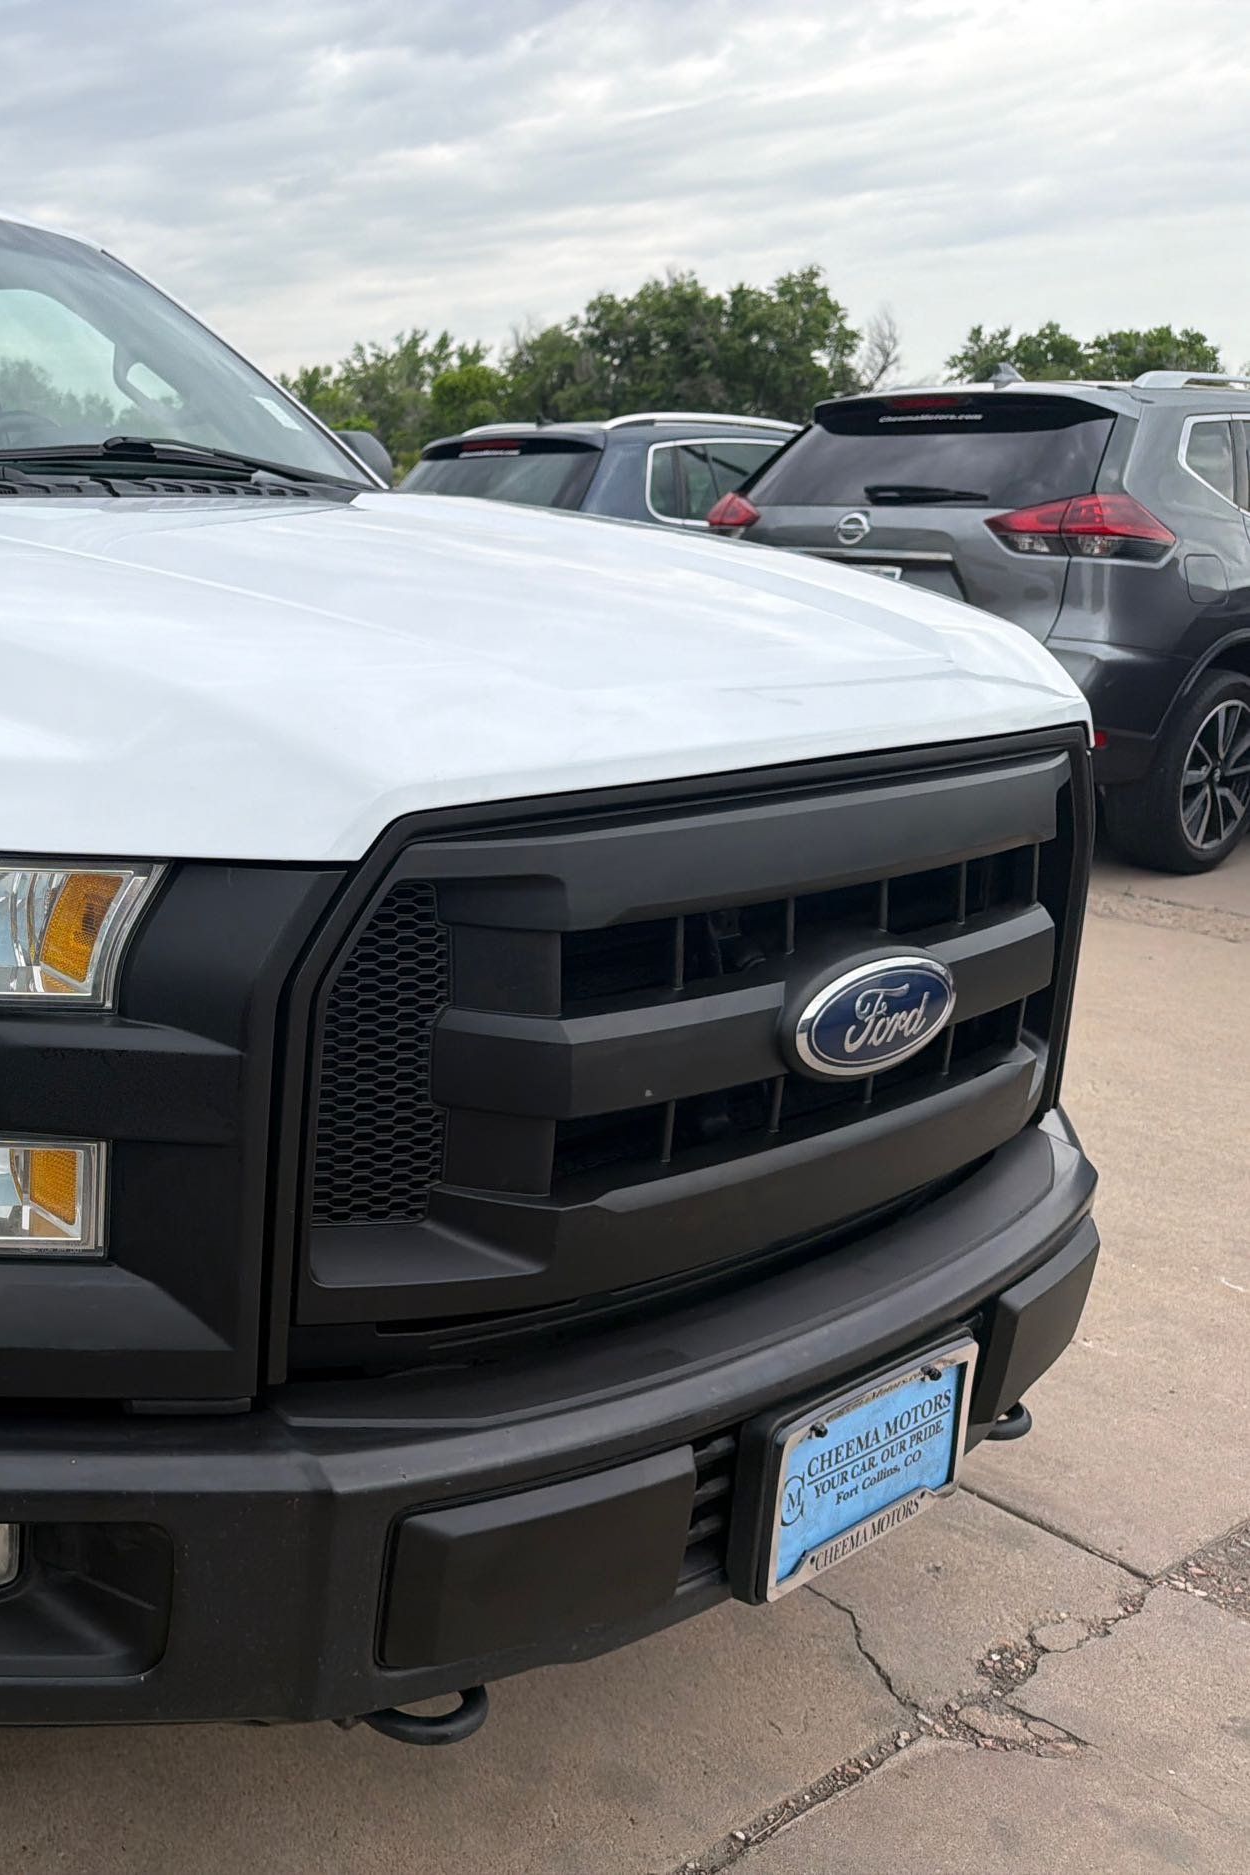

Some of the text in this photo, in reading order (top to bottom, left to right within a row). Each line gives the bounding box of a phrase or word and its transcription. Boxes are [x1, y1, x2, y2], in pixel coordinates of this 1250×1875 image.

[844, 983, 930, 1053] Ford
[807, 1389, 952, 1478] CHEEMA MOTORS
[814, 1465, 849, 1499] YOUR
[881, 1440, 907, 1463] OUR
[835, 1484, 860, 1506] Fort
[904, 1450, 922, 1468] CO
[815, 1495, 920, 1571] CHEEMA MOTORS
